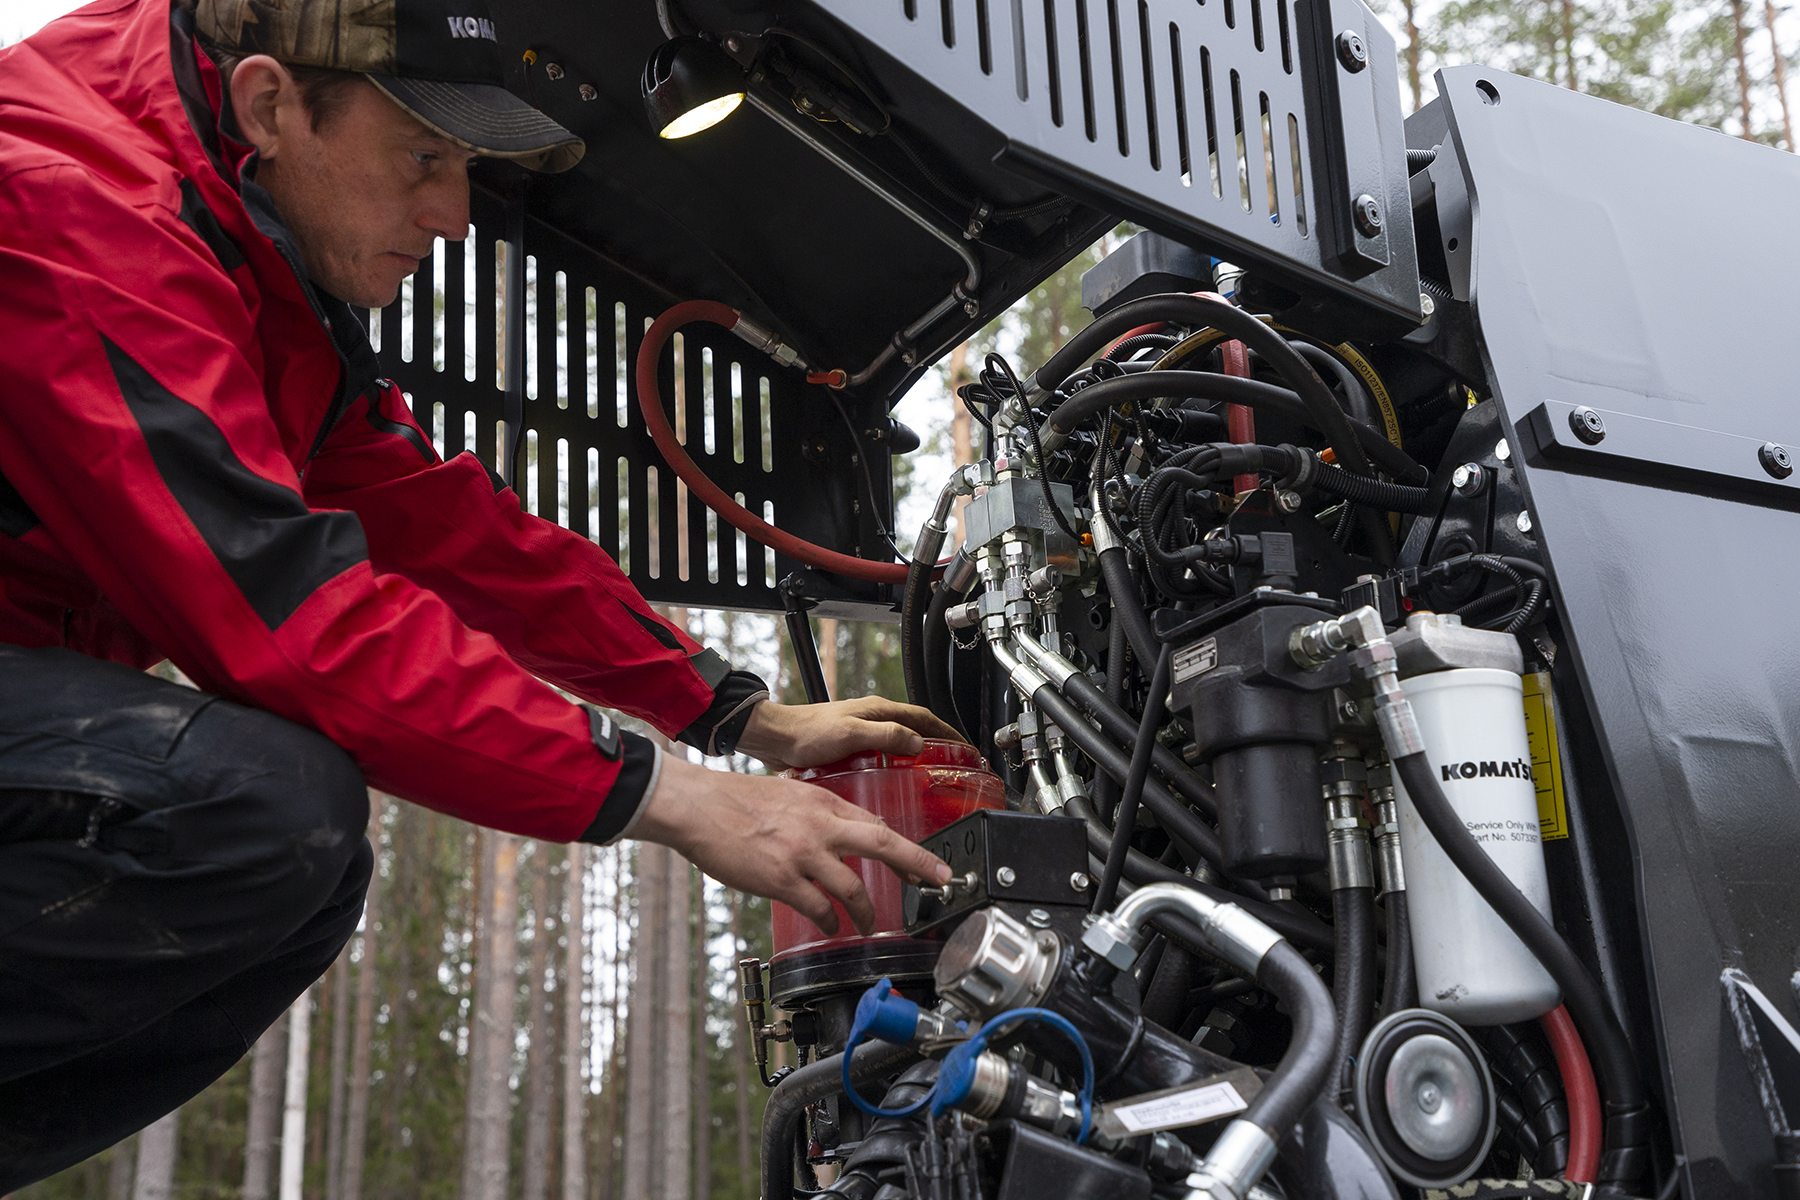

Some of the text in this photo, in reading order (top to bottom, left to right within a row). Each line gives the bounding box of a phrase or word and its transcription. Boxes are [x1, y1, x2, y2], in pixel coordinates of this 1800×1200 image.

[1467, 821, 1503, 831] Service
[1506, 820, 1524, 832] Only
[1492, 833, 1508, 842] No.
